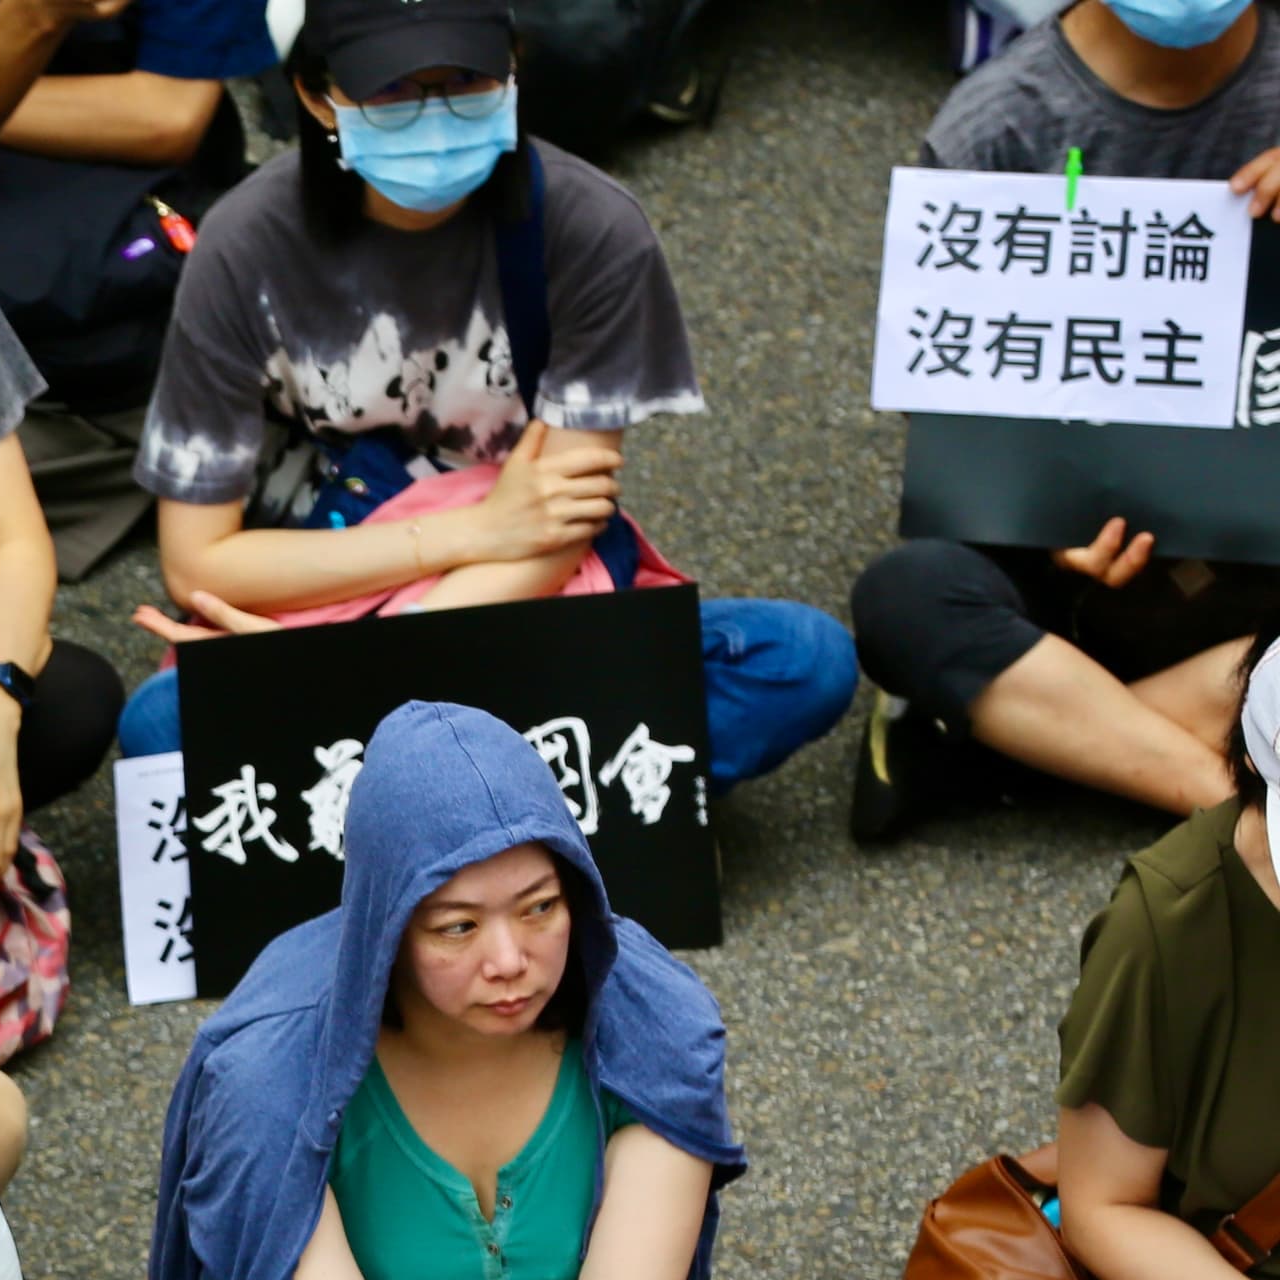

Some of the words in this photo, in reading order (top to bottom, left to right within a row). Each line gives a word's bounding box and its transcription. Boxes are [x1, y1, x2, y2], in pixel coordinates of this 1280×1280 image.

[916, 202, 1216, 282] 沒有討論
[906, 308, 1204, 387] 沒有民主
